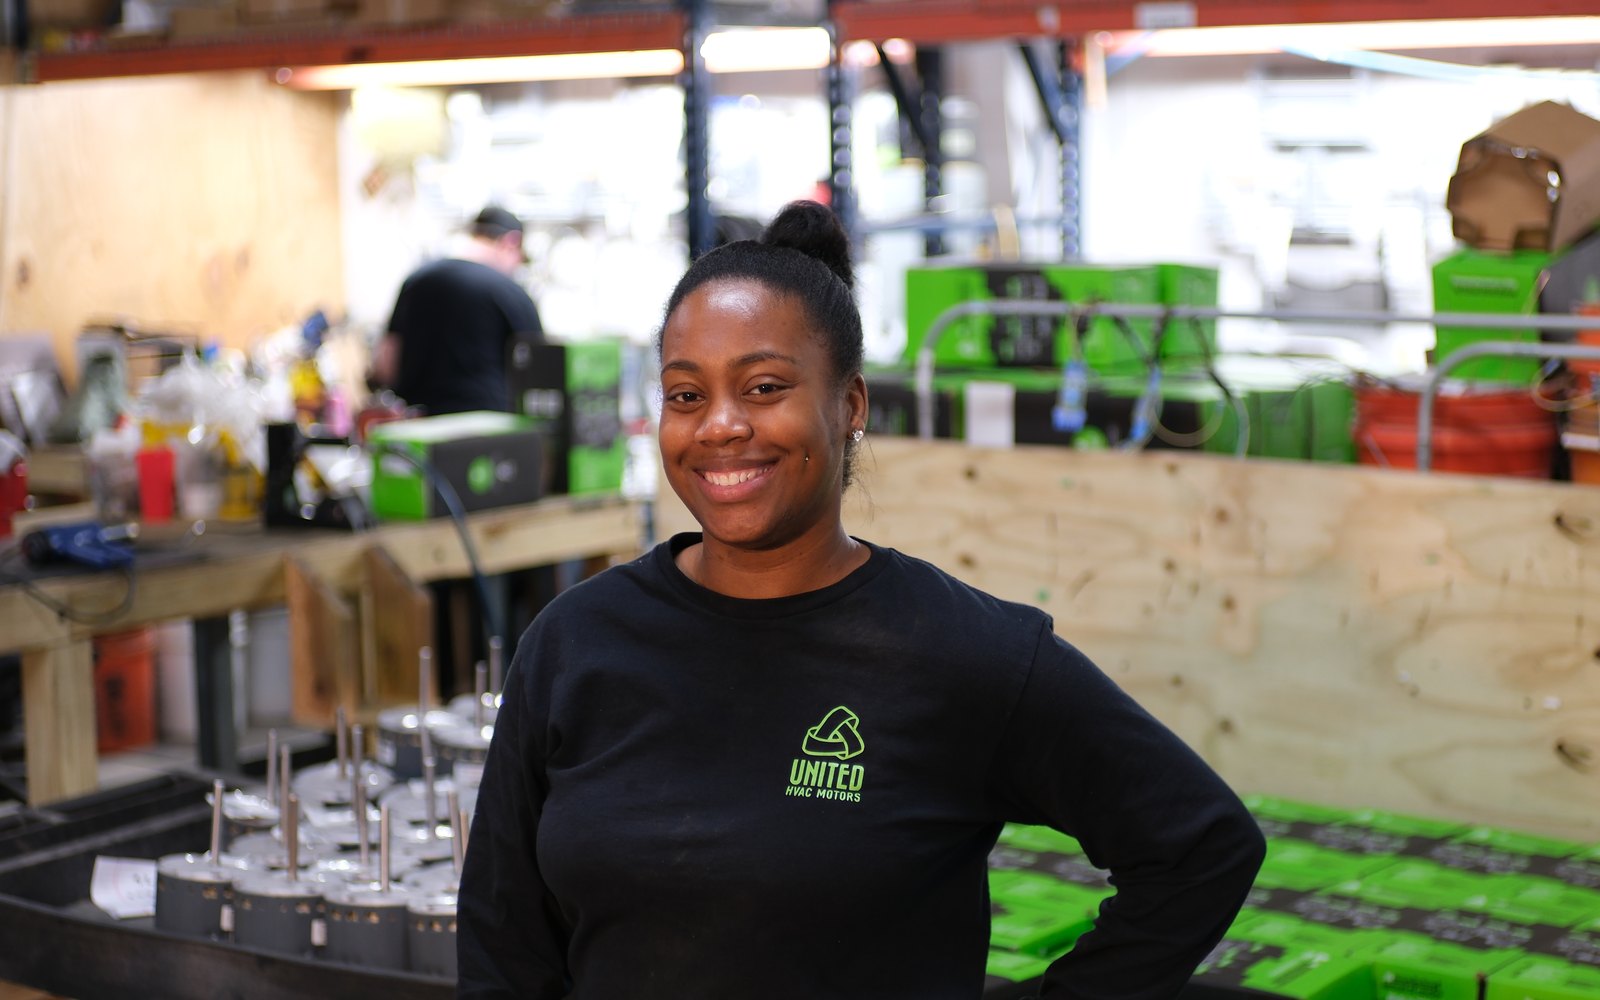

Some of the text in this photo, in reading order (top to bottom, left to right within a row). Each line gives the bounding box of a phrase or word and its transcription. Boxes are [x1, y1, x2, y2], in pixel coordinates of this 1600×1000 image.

[789, 759, 865, 792] UNITED
[785, 785, 861, 803] HVAC MOTORS
